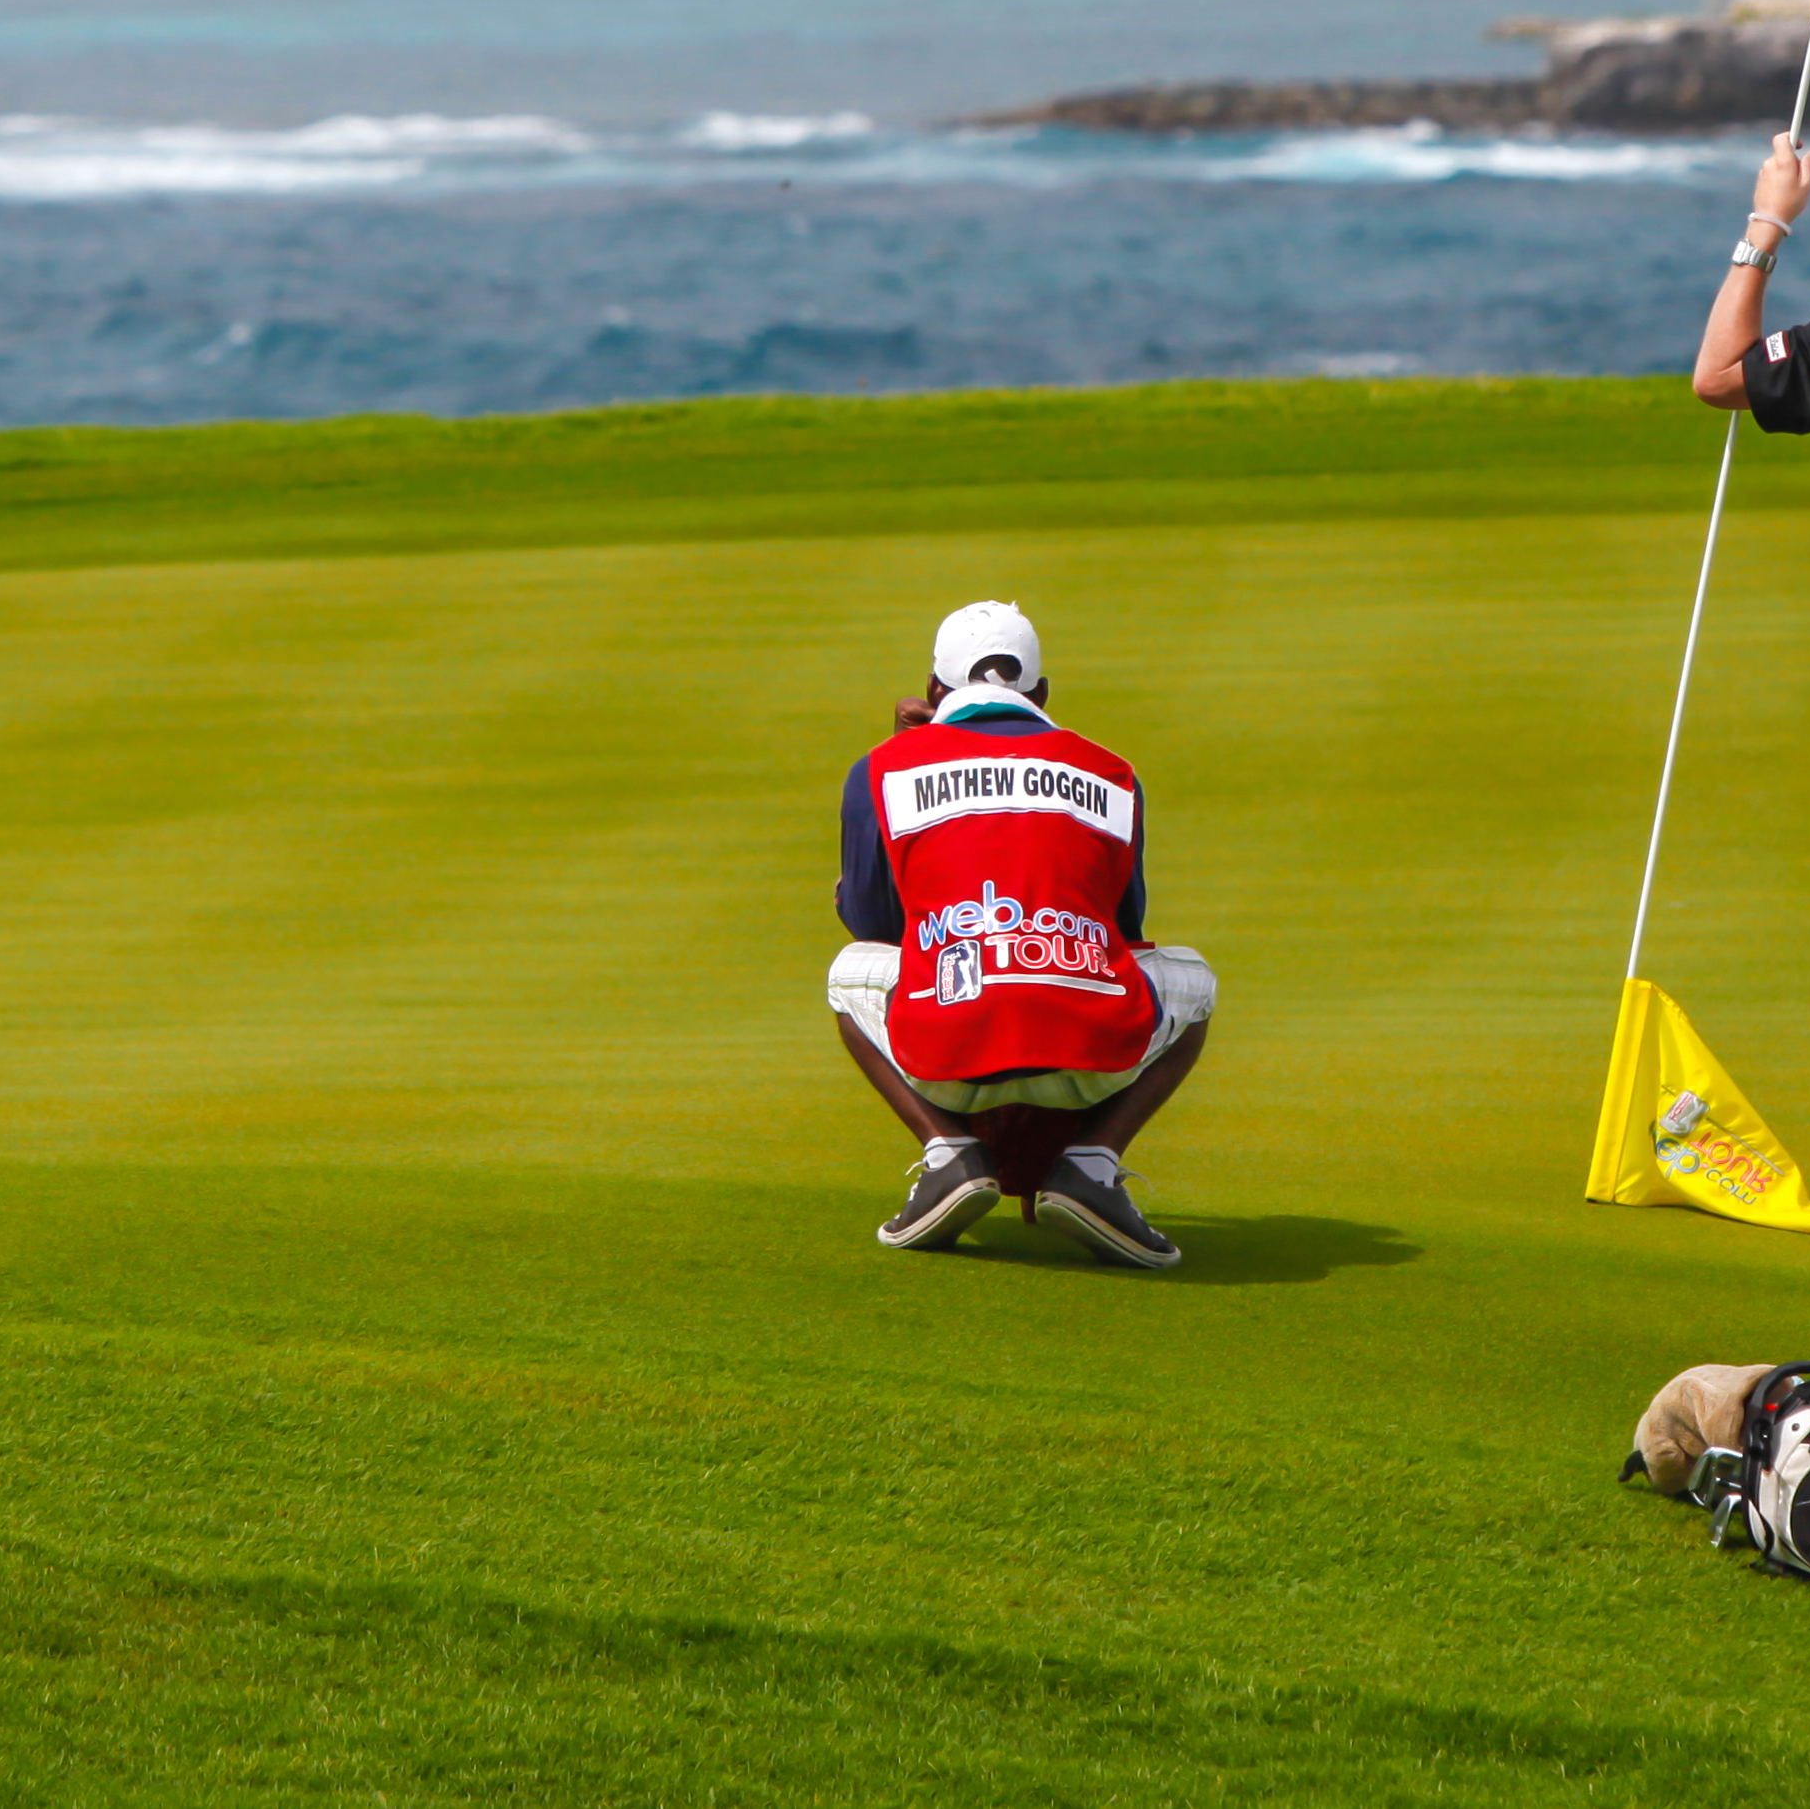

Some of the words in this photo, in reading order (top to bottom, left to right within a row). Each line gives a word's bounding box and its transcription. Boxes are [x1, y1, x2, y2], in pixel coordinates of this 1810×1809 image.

[914, 767, 1015, 814] MATHEW
[1023, 766, 1108, 819] GOGGIN
[918, 880, 1109, 951] web.com
[984, 933, 1116, 978] TOUR
